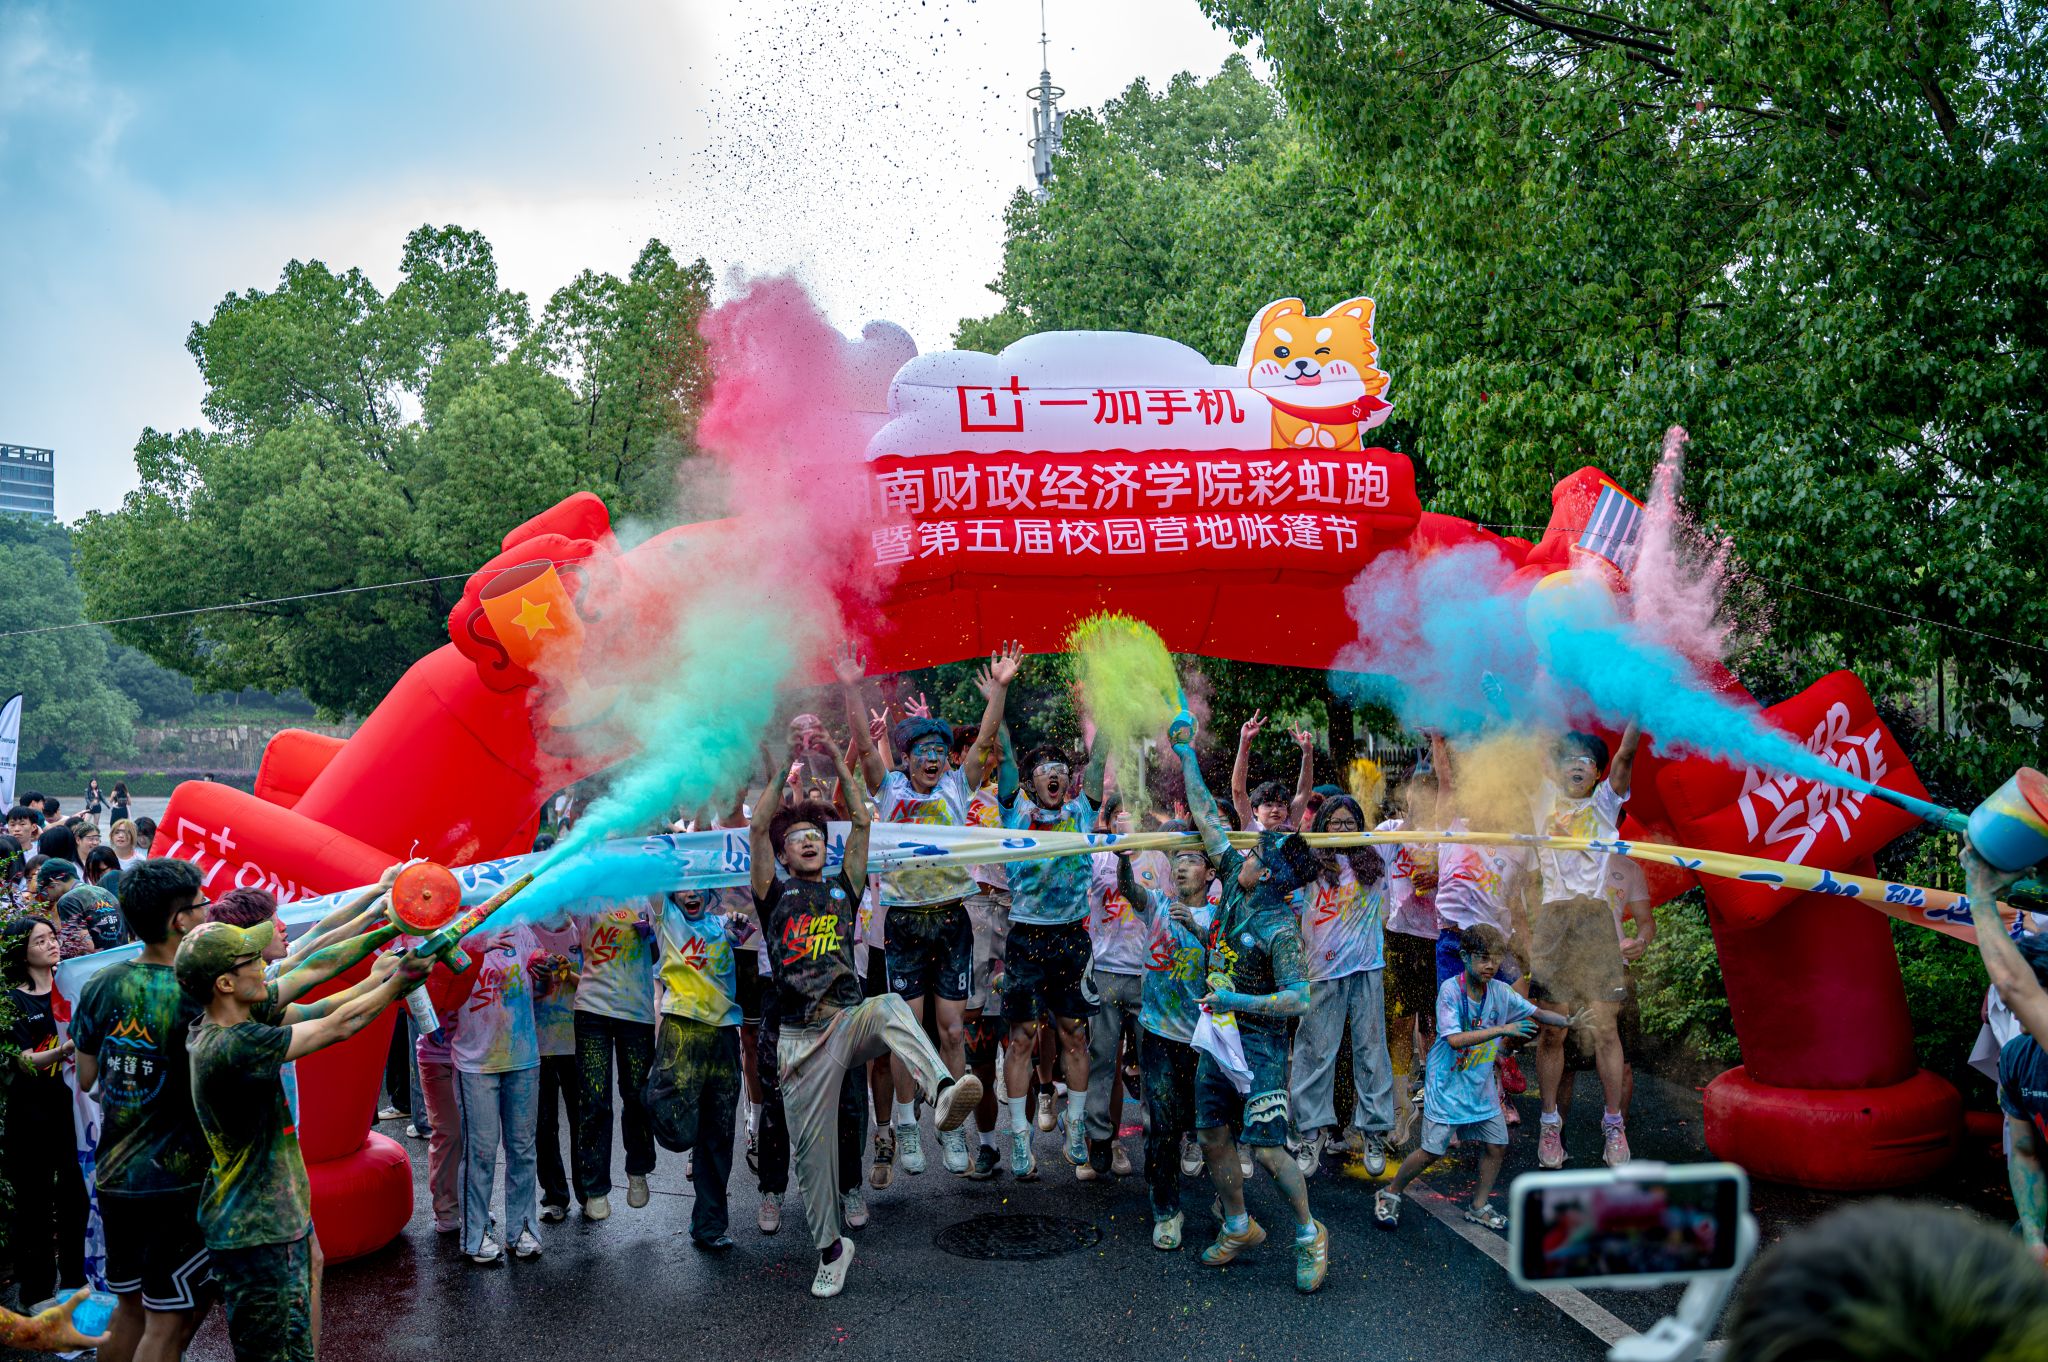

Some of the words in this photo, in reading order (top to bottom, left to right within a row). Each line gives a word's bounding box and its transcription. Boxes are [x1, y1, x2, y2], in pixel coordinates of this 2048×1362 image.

[1039, 388, 1246, 426] 一加手机
[871, 513, 1359, 567] 暨第五届校园营地帐篷节
[782, 913, 839, 945] NEVER
[957, 972, 966, 990] 8
[107, 1055, 153, 1076] 帐篷节
